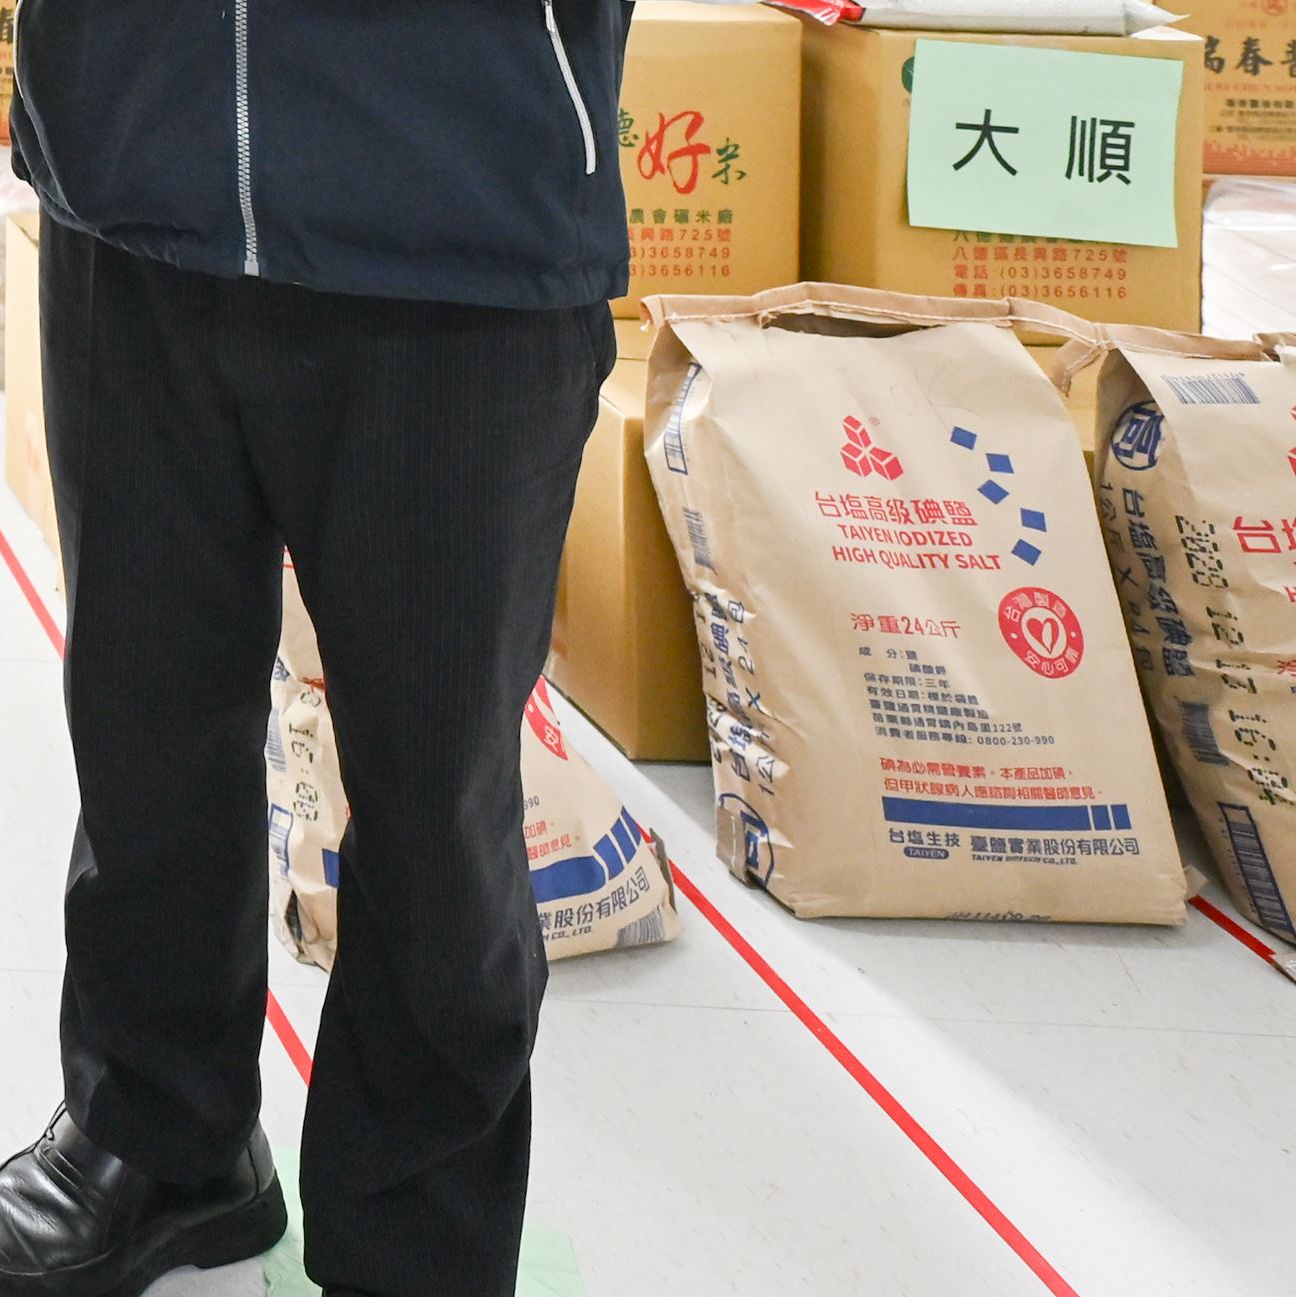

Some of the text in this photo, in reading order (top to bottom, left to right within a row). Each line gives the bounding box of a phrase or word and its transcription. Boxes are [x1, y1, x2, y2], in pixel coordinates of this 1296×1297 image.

[953, 109, 1136, 185] 大順
[837, 524, 973, 547] TAIYEN IODIZED
[832, 546, 1003, 571] HIGH QUALITY SALT
